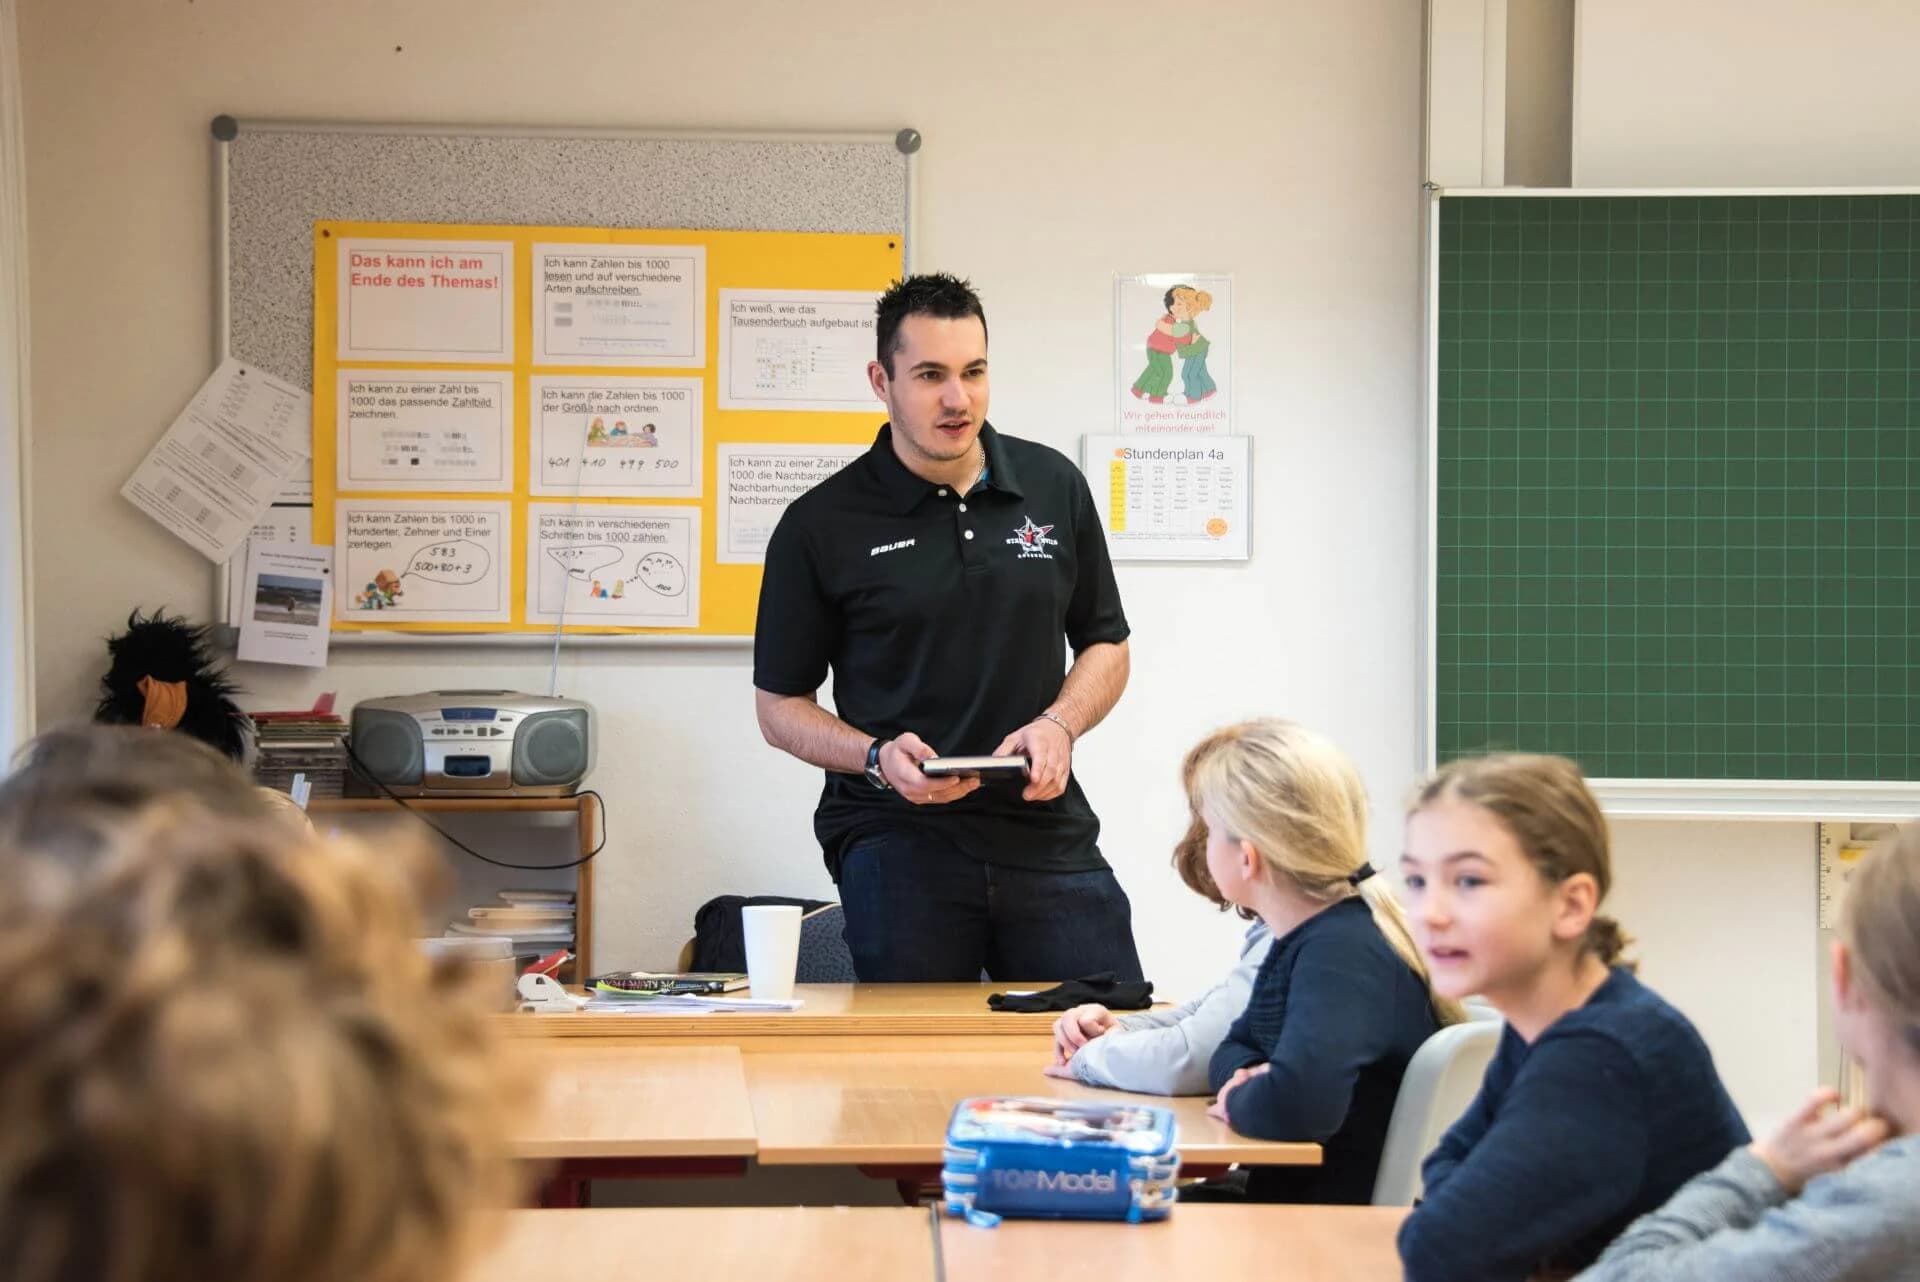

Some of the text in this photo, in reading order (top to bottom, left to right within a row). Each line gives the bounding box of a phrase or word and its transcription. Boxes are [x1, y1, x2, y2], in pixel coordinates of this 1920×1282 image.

[351, 254, 483, 270] Das kann ich am
[545, 258, 670, 270] Ich kann Zahlen bis 1000
[351, 273, 498, 289] Ende des Themas!
[545, 271, 682, 283] lesen und auf verschiedene
[545, 284, 642, 296] Arten aufschreiben.
[731, 303, 816, 314] Ich weiß, wie das
[732, 316, 807, 328] Tausenderbuch
[810, 317, 859, 330] aufgebaut
[350, 384, 479, 394] Ich kann zu einer Zahl bis
[543, 390, 685, 401] Ich kann die Zahlen bis 1000
[351, 396, 492, 409] 1000 das passende Zahlbild
[542, 402, 559, 412] der
[562, 402, 594, 413] Größe
[596, 403, 621, 413] nach
[1124, 410, 1227, 423] Wir gehen freundlich
[1123, 447, 1225, 463] Stundenplan 4a
[654, 459, 679, 469] 500
[730, 458, 745, 467] Ich
[747, 458, 771, 468] kann
[774, 460, 787, 468] zu
[789, 459, 814, 468] einer
[816, 459, 839, 469] Zahl
[731, 470, 755, 480] 1000
[757, 471, 773, 480] die
[348, 514, 487, 524] Ich kann Zahlen bis 1000 in
[540, 517, 670, 529] Ich kann in verschiedenen
[404, 527, 440, 537] Zehner
[443, 527, 462, 537] und
[465, 527, 492, 537] Einer
[540, 530, 585, 541] Schritten
[587, 531, 603, 541] bis
[605, 531, 631, 542] 1000
